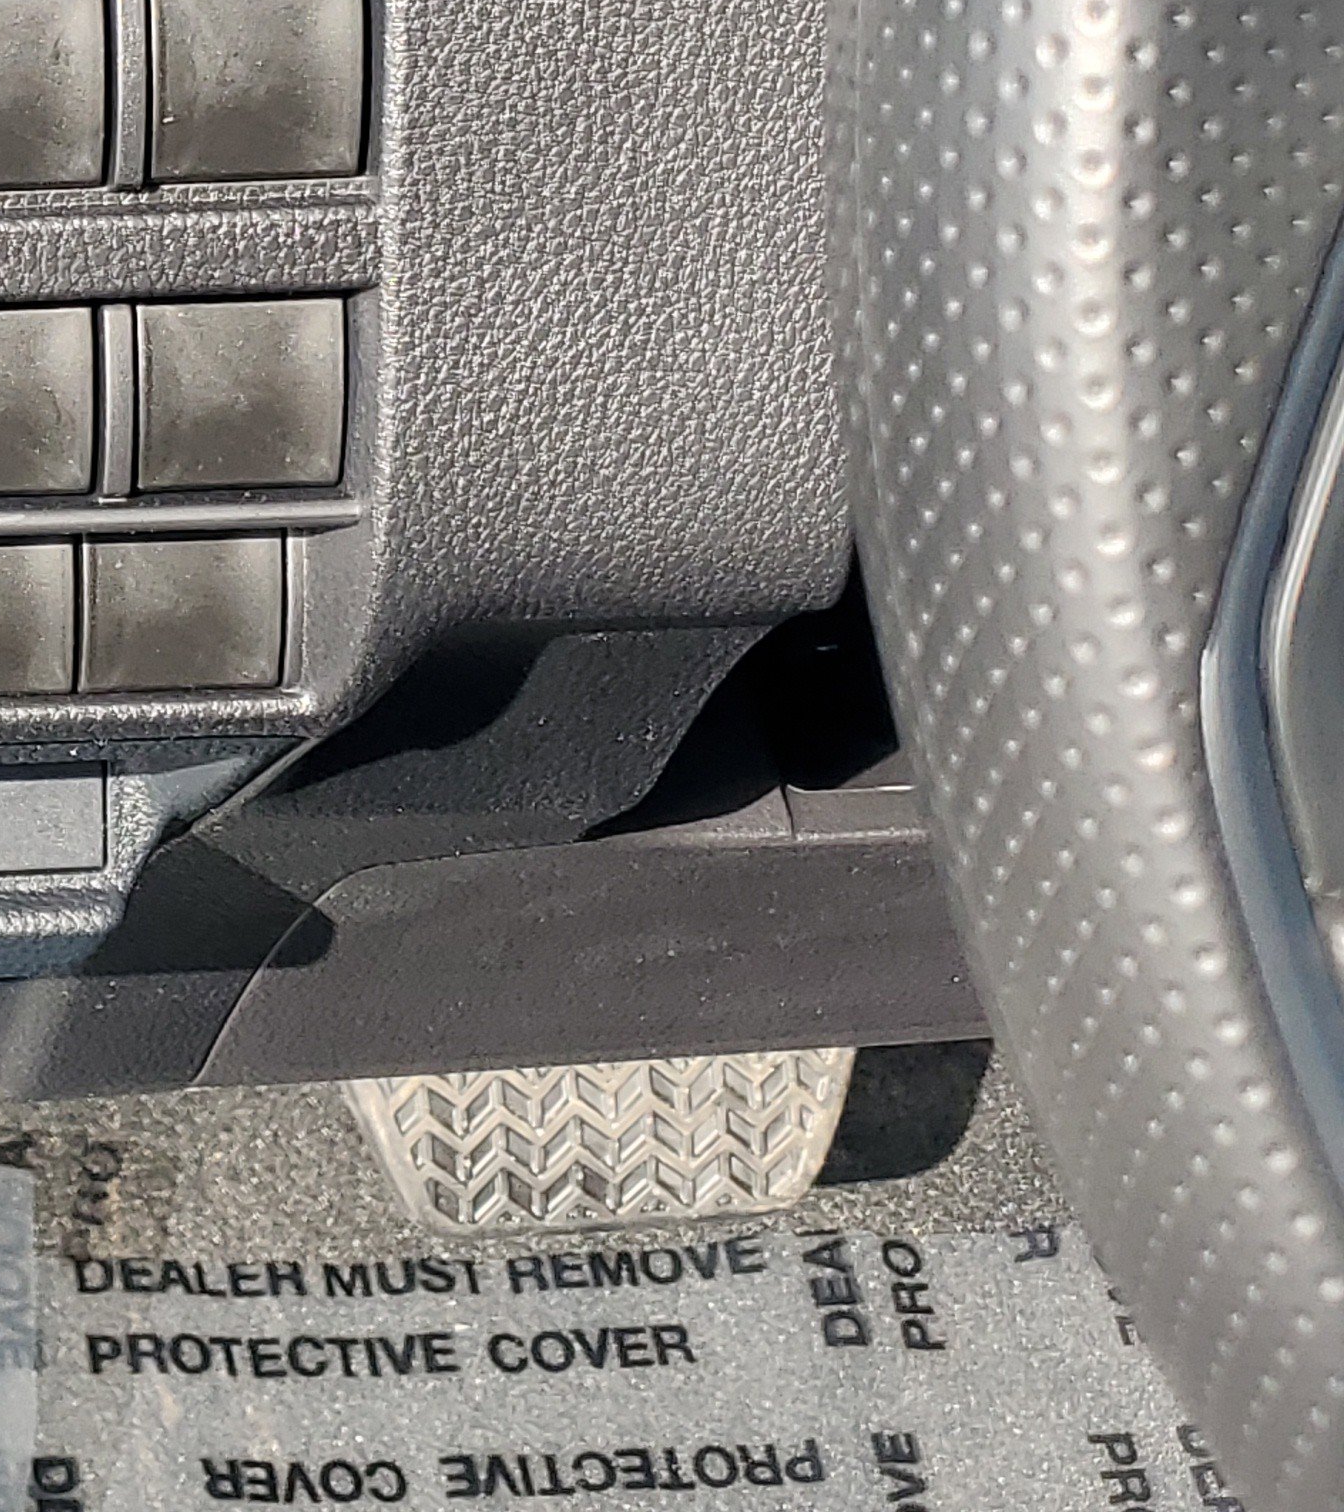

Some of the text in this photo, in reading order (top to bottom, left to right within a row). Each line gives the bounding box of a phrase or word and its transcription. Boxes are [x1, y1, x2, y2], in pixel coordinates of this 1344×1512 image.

[72, 1235, 766, 1299] DEALER MUST REMOVE
[86, 1324, 698, 1378] PROTECTIVE COVER
[199, 1438, 826, 1503] PROTECTIVE COVER
